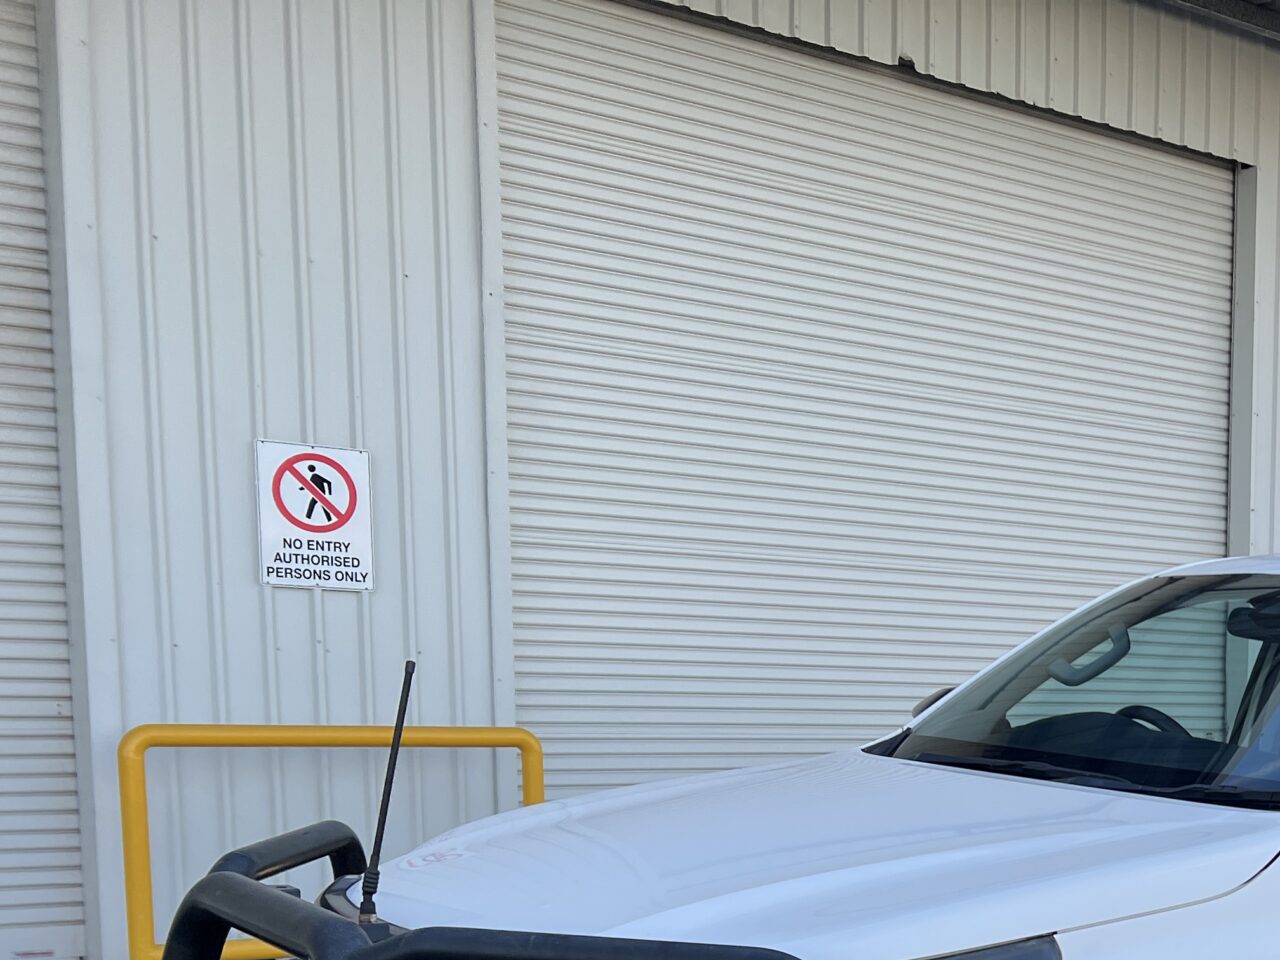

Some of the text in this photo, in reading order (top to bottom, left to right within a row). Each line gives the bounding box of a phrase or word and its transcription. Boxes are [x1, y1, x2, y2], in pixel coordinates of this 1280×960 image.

[283, 538, 351, 553] NO ENTRY
[273, 552, 361, 568] AUTHORISED
[266, 567, 369, 583] PERSONS ONLY
